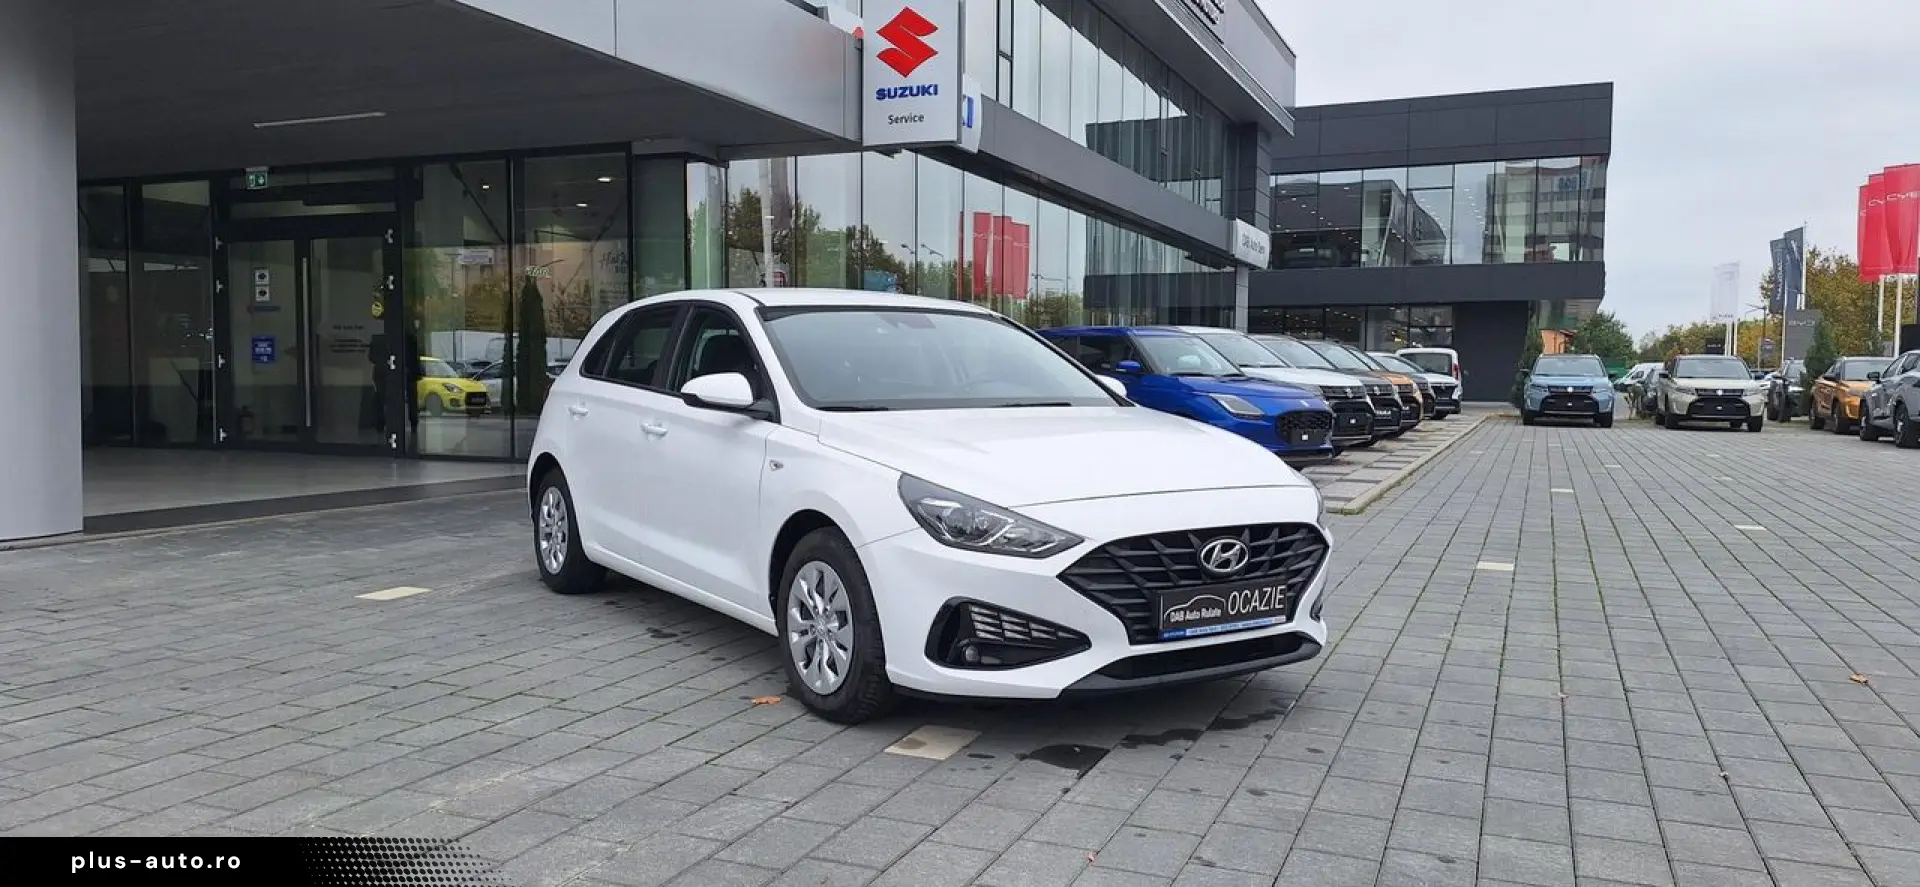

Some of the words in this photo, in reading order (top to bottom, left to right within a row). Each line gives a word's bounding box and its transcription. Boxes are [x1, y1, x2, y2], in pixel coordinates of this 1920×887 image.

[876, 84, 938, 100] SUZUKI
[888, 112, 924, 125] Service
[1228, 584, 1286, 615] OCAZIE
[1185, 609, 1200, 620] Auto
